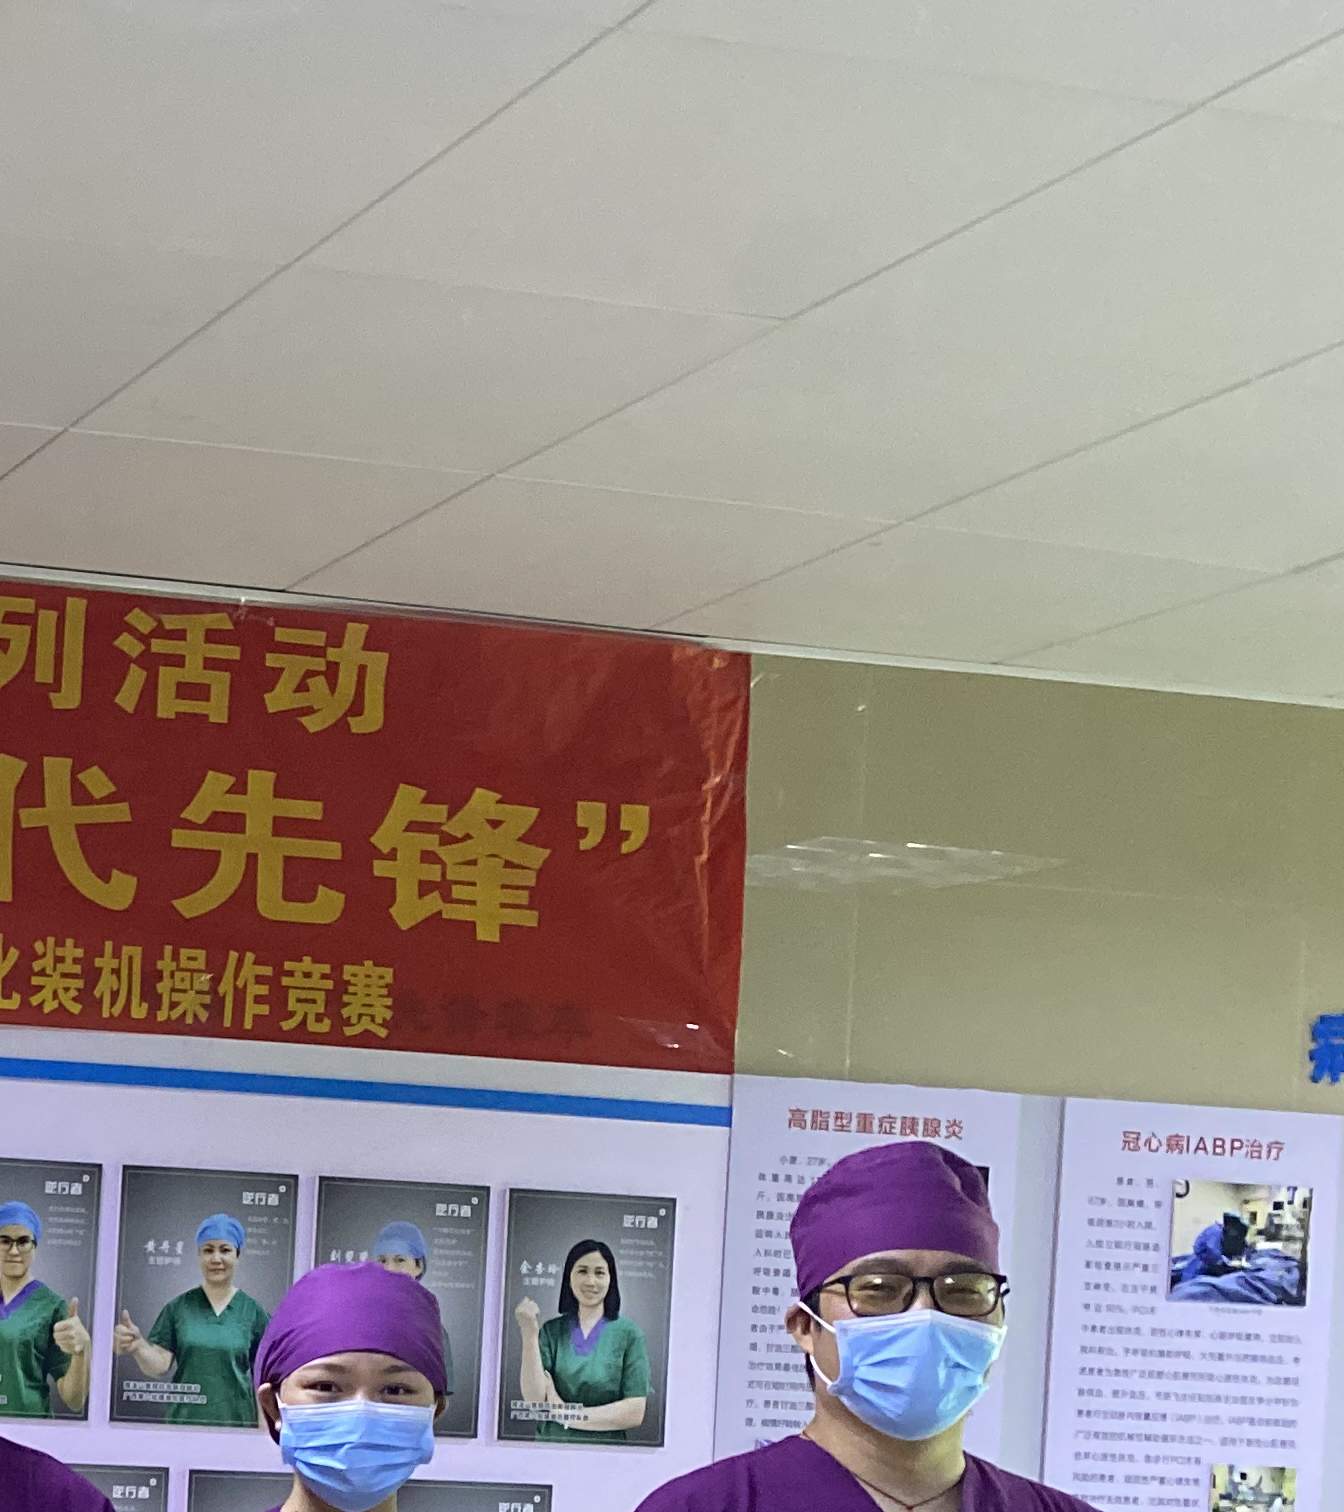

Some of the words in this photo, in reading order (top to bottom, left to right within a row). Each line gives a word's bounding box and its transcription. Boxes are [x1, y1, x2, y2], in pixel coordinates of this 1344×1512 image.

[787, 1108, 964, 1140] 高脂型重症胰腺炎
[1121, 1130, 1286, 1161] 冠心病IABP治疗
